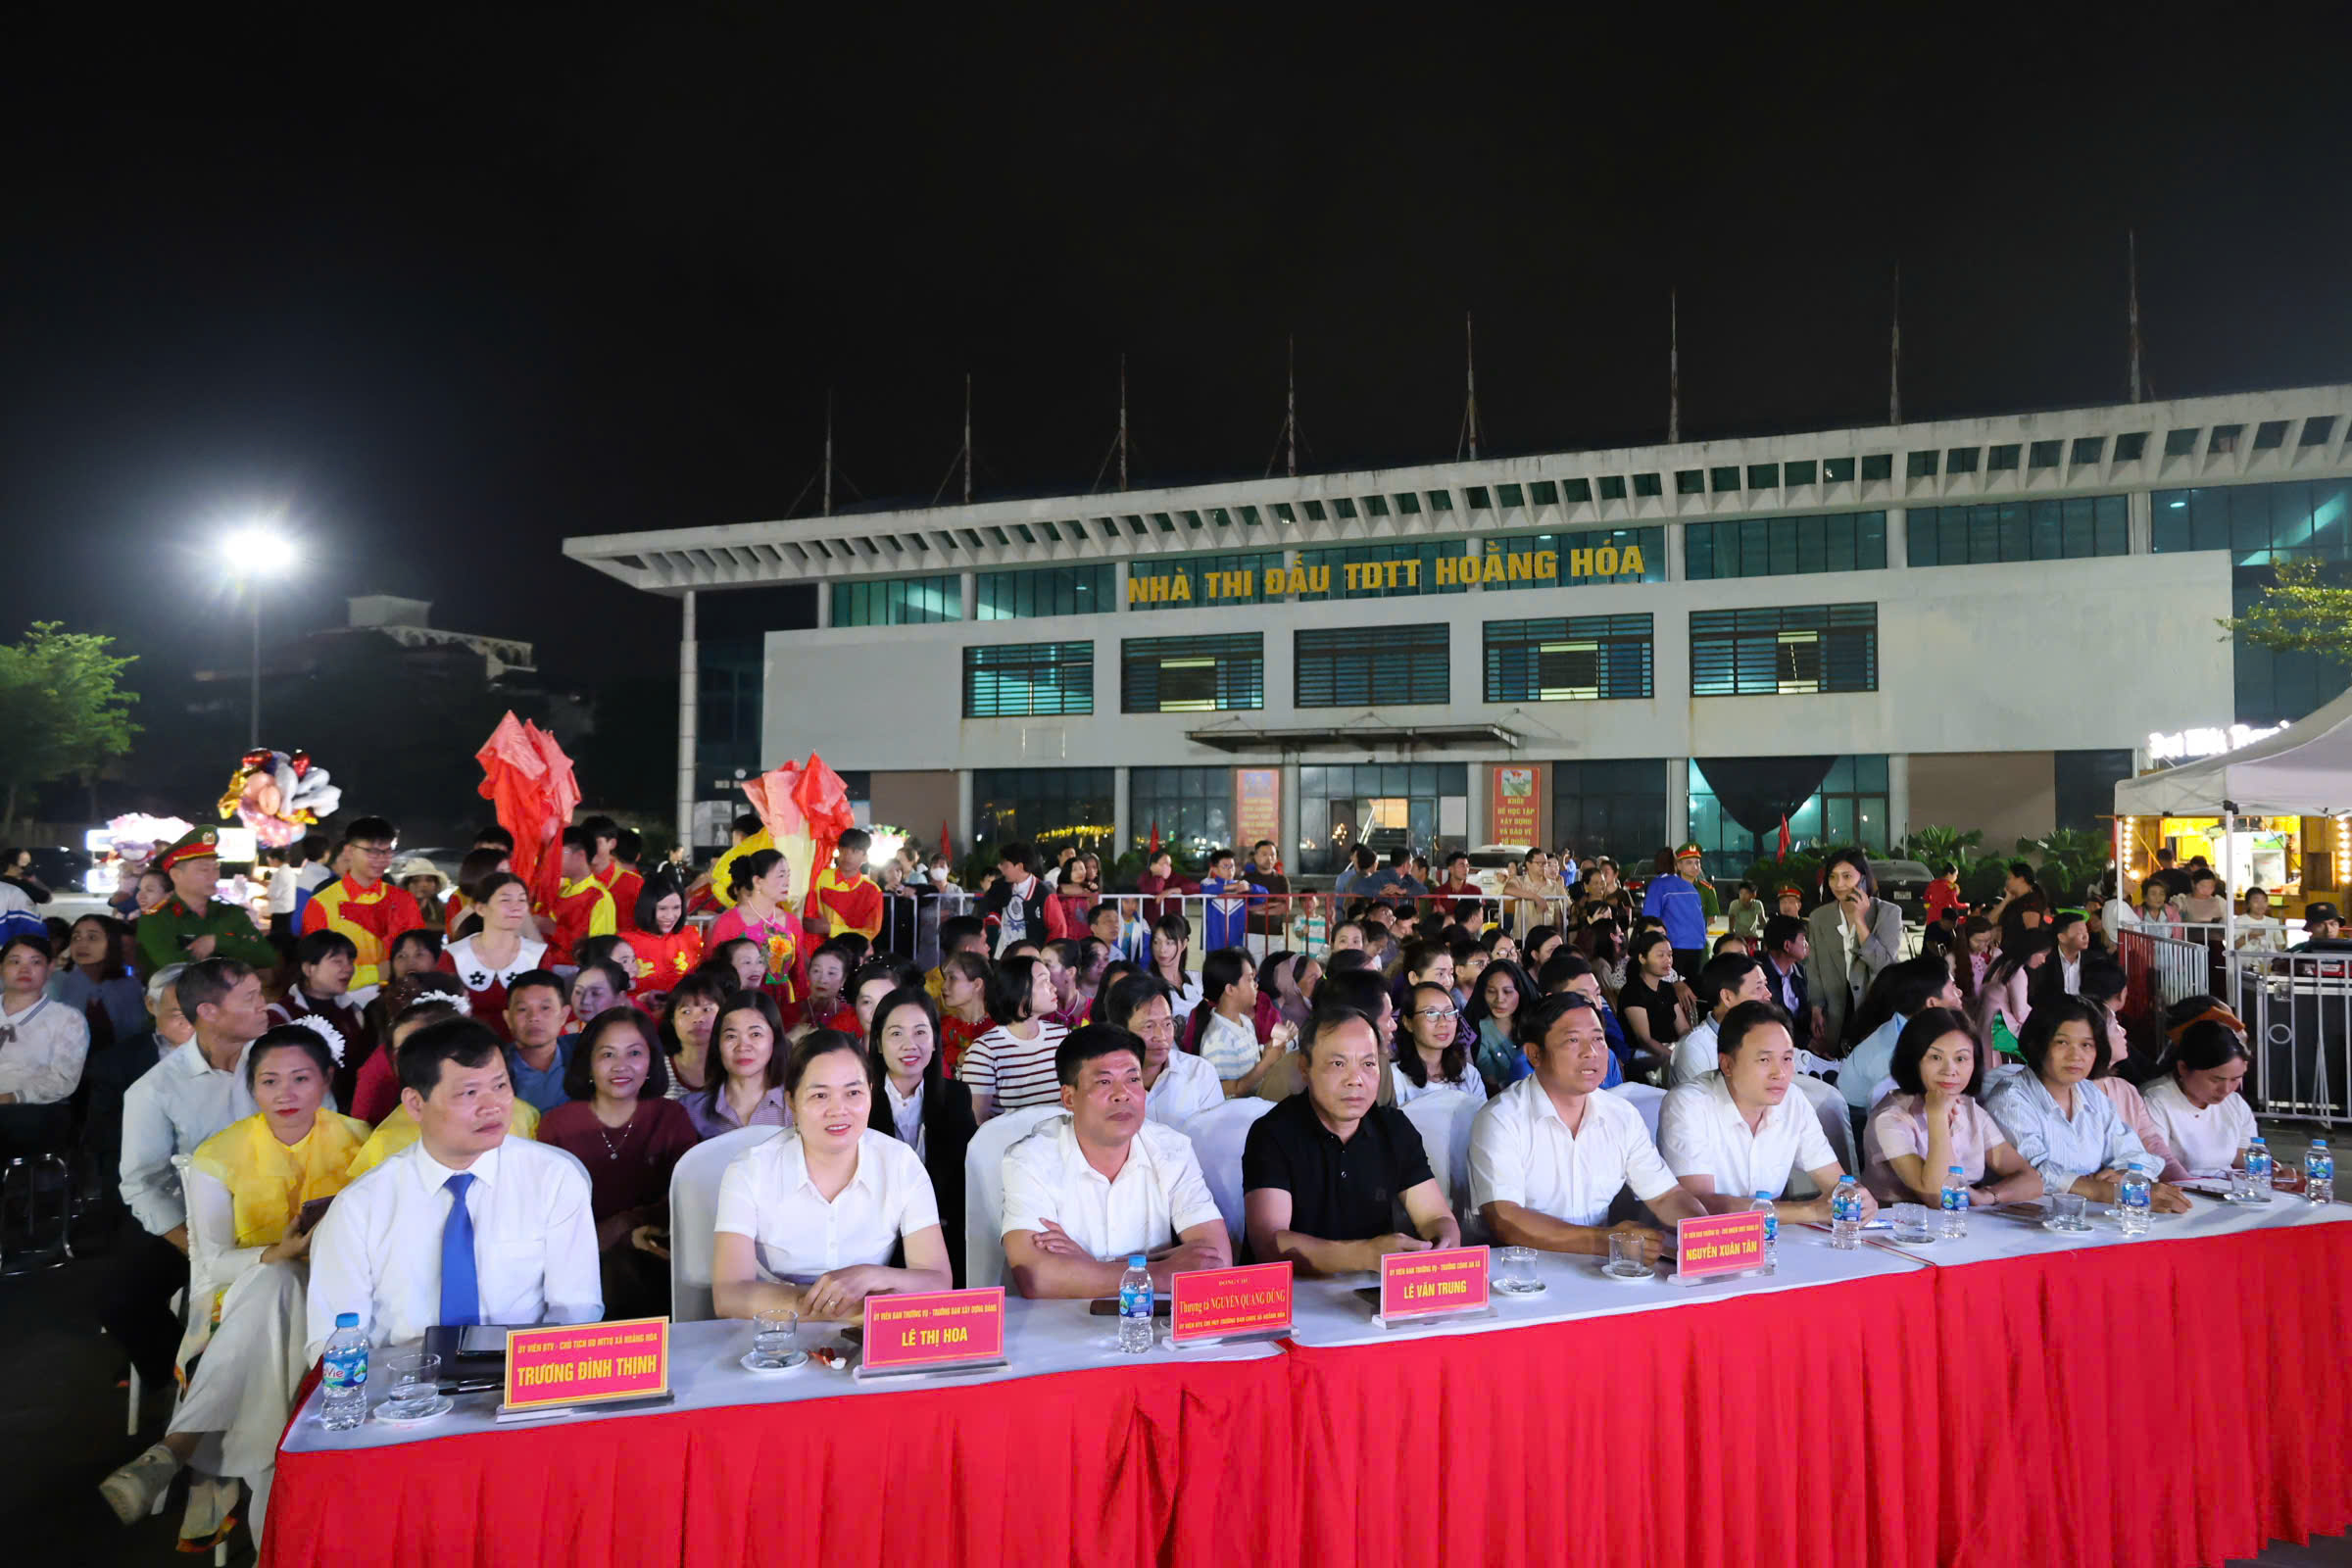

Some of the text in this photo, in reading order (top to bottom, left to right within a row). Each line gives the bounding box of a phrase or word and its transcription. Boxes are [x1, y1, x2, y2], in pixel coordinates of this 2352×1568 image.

[1128, 539, 1645, 603] NHÀ THI ĐẤU TDTT HOẰNG HÓA
[1719, 1241, 1740, 1257] XUÂN
[1403, 1280, 1467, 1299] LÊ VĂN TRUNG
[1240, 1292, 1265, 1309] QUANG
[902, 1327, 968, 1348] LÊ THỊ HOA
[517, 1354, 658, 1387] TRƯƠNG ĐÌNH THỊNH
